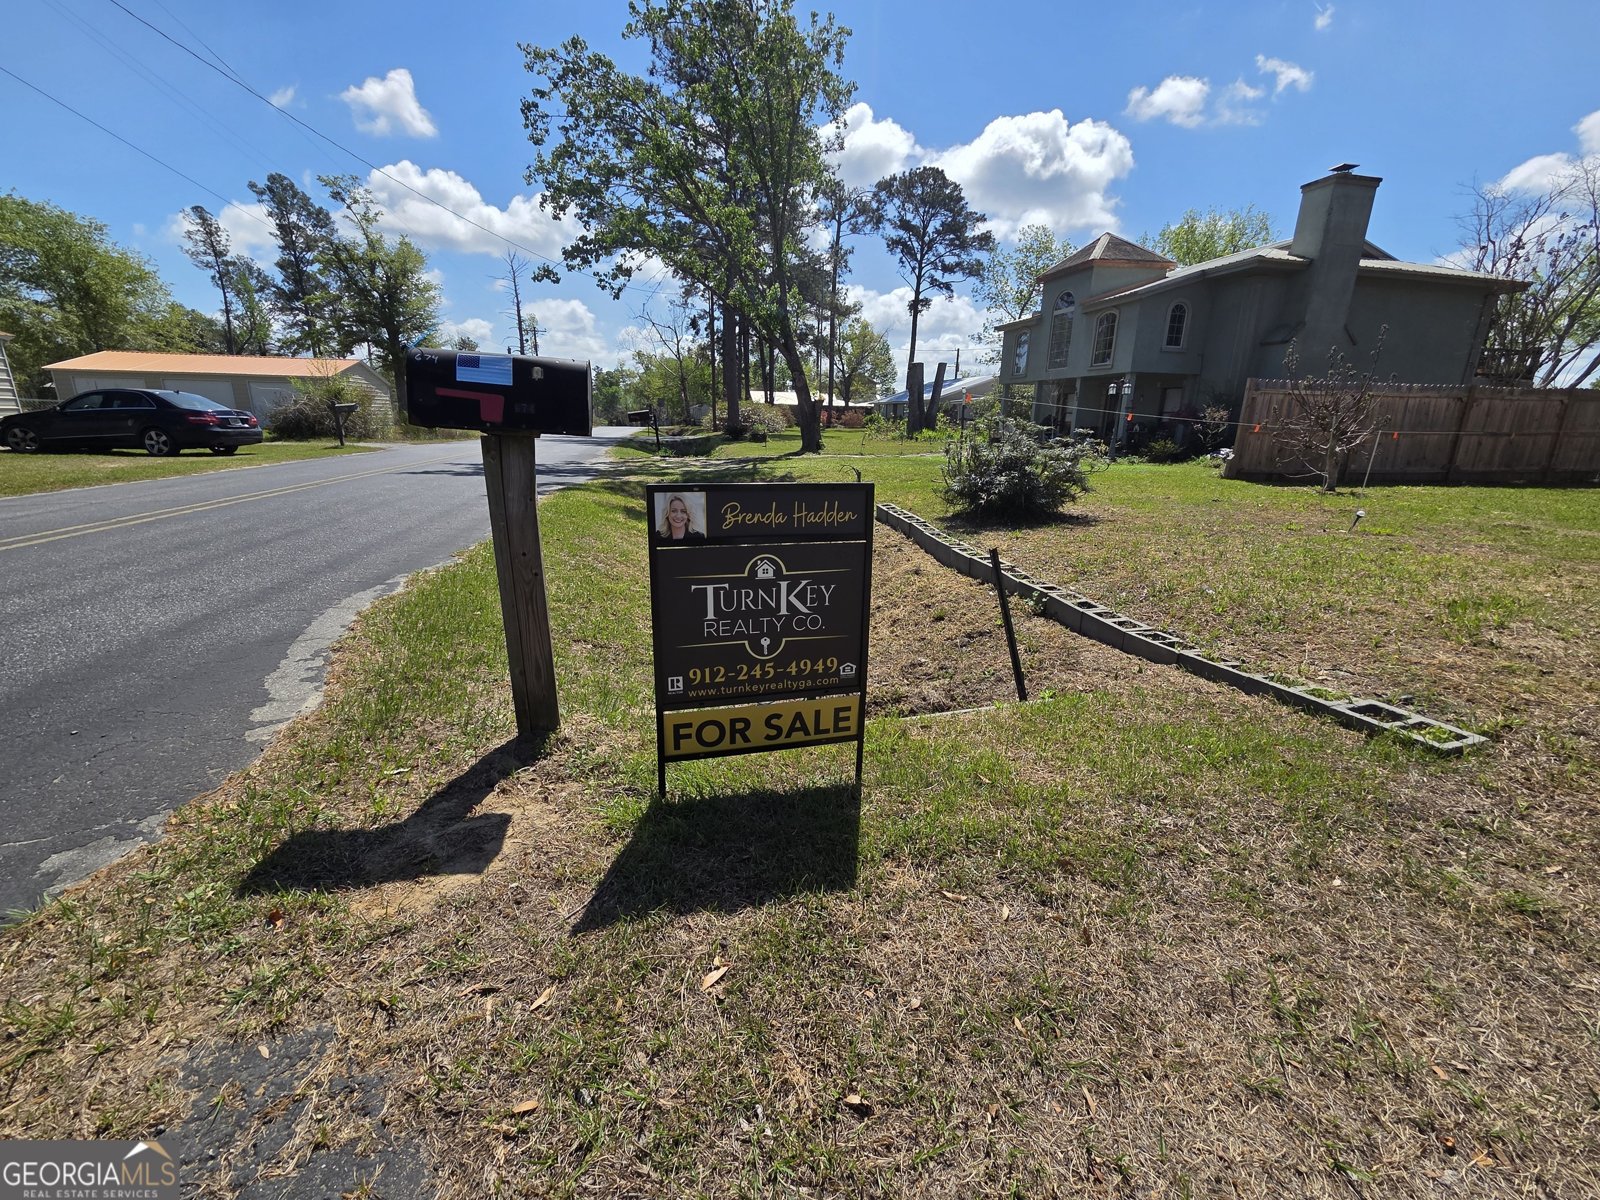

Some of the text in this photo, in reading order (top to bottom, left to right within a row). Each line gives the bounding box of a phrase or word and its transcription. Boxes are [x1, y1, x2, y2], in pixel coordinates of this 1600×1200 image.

[414, 353, 439, 364] 674
[721, 501, 857, 529] Brenda Hadden
[704, 615, 825, 637] REALTY CO.
[688, 656, 838, 686] 912-245-4949
[688, 676, 839, 697] www.turnkeyrealtyga.com
[672, 706, 852, 751] FOR SALE
